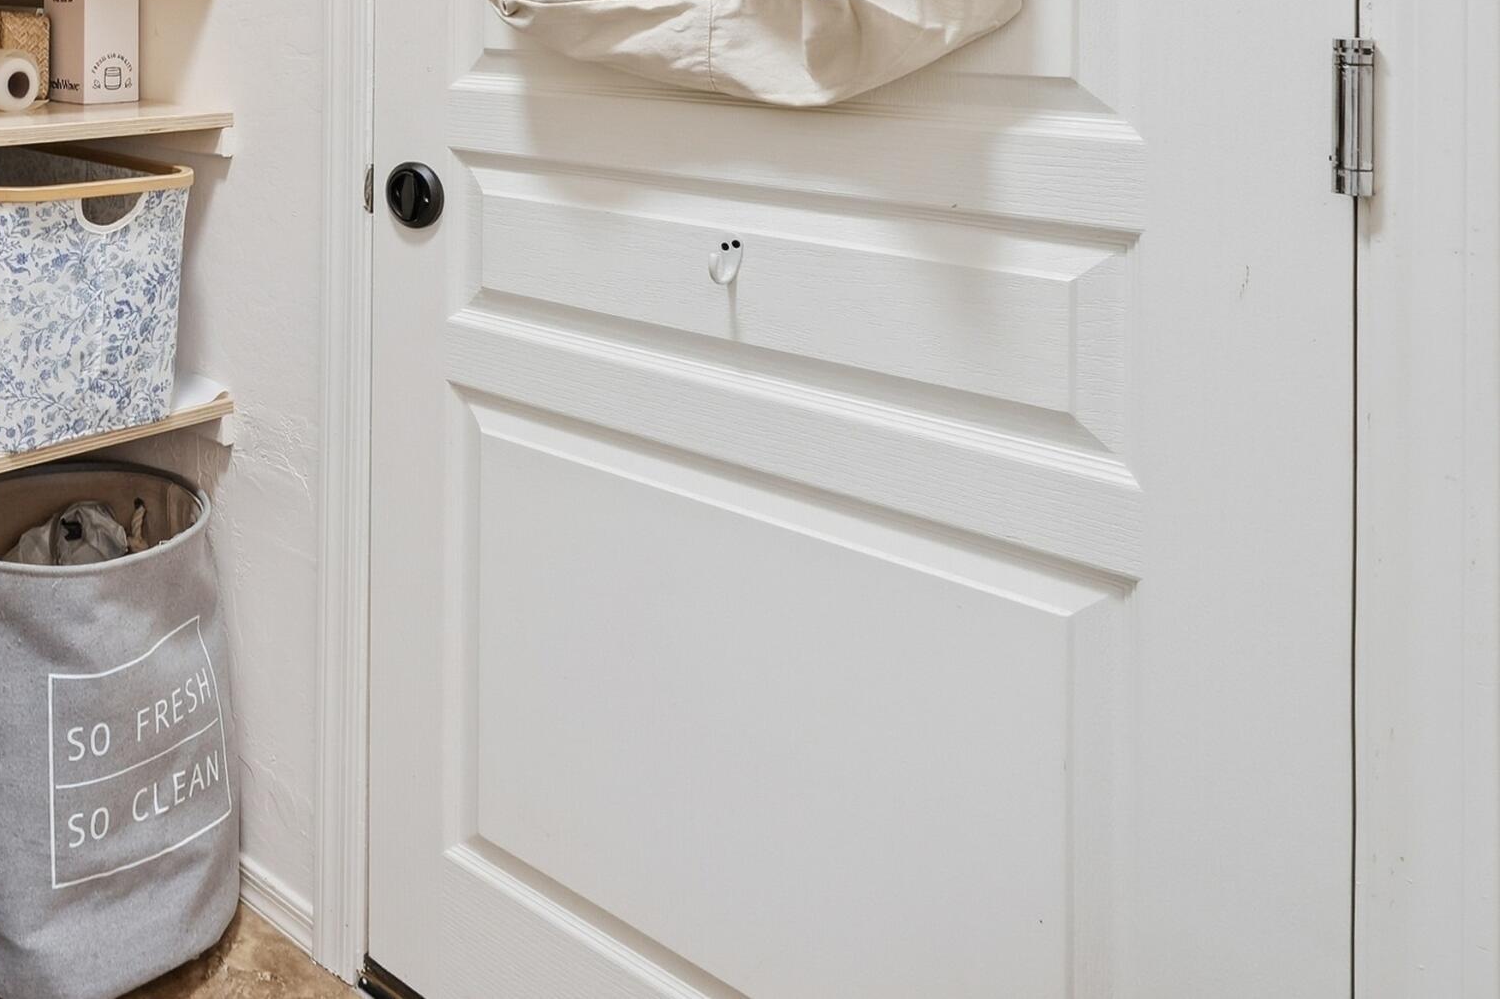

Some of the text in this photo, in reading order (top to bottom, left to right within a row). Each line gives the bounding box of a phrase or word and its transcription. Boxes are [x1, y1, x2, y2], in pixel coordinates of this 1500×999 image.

[66, 667, 212, 762] SO FRESH
[67, 750, 219, 848] SO CLEAN
